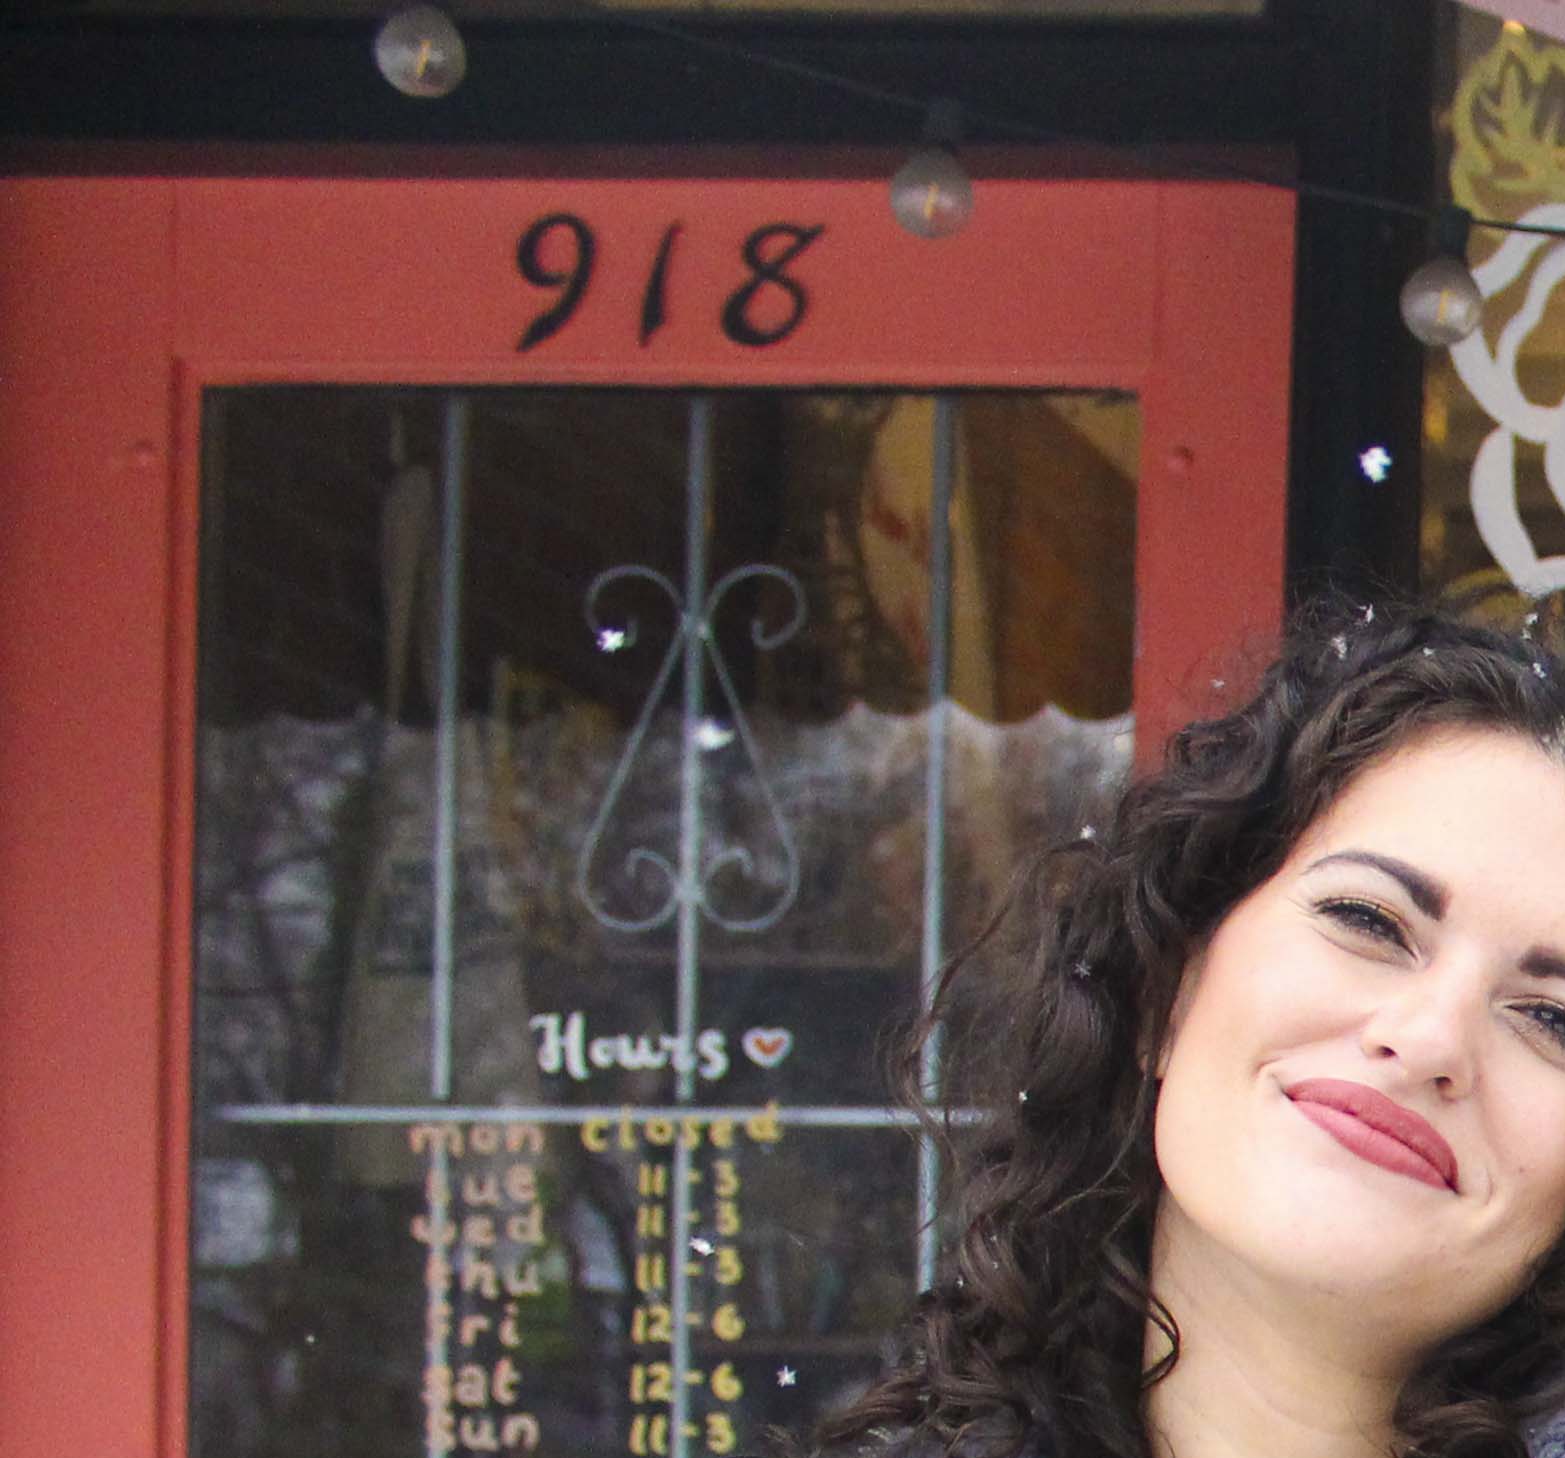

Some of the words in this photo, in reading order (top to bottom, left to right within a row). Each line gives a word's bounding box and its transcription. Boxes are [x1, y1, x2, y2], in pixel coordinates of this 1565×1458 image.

[515, 211, 825, 352] 918
[529, 1010, 730, 1081] Hours
[409, 1120, 545, 1158] mon
[580, 1100, 784, 1152] closed
[410, 1202, 547, 1247] wed
[426, 1252, 542, 1299] thu
[426, 1302, 522, 1349] fri
[421, 1355, 522, 1406] sat
